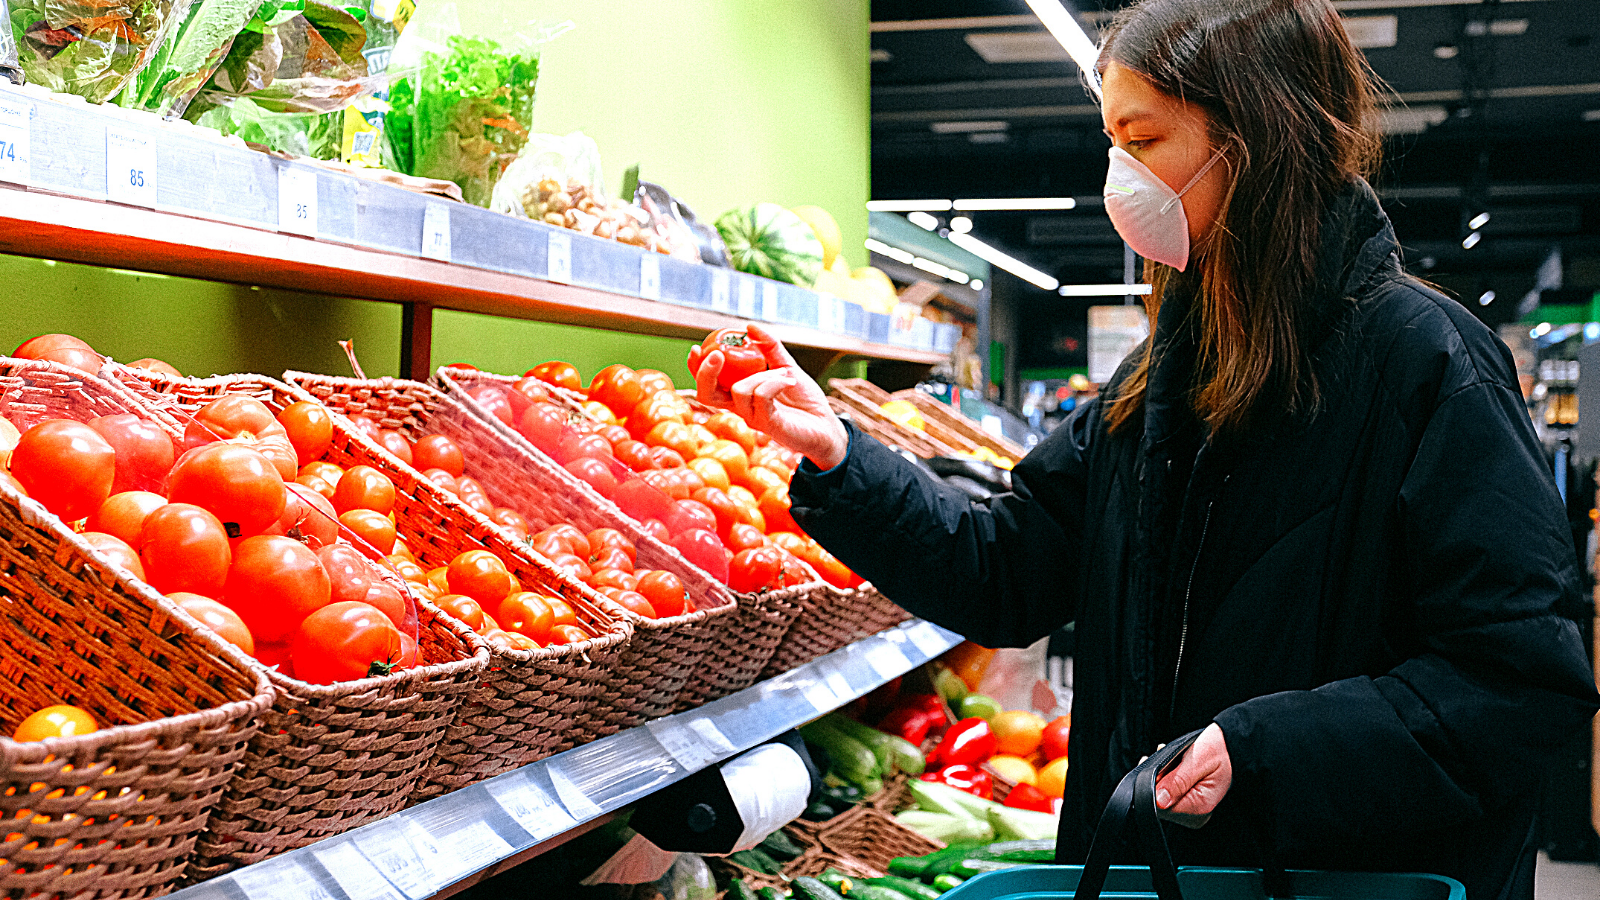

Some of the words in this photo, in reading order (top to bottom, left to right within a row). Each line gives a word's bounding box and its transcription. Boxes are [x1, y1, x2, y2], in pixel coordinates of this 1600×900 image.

[0, 140, 16, 162] 74
[130, 168, 144, 188] 85
[296, 203, 308, 219] 85
